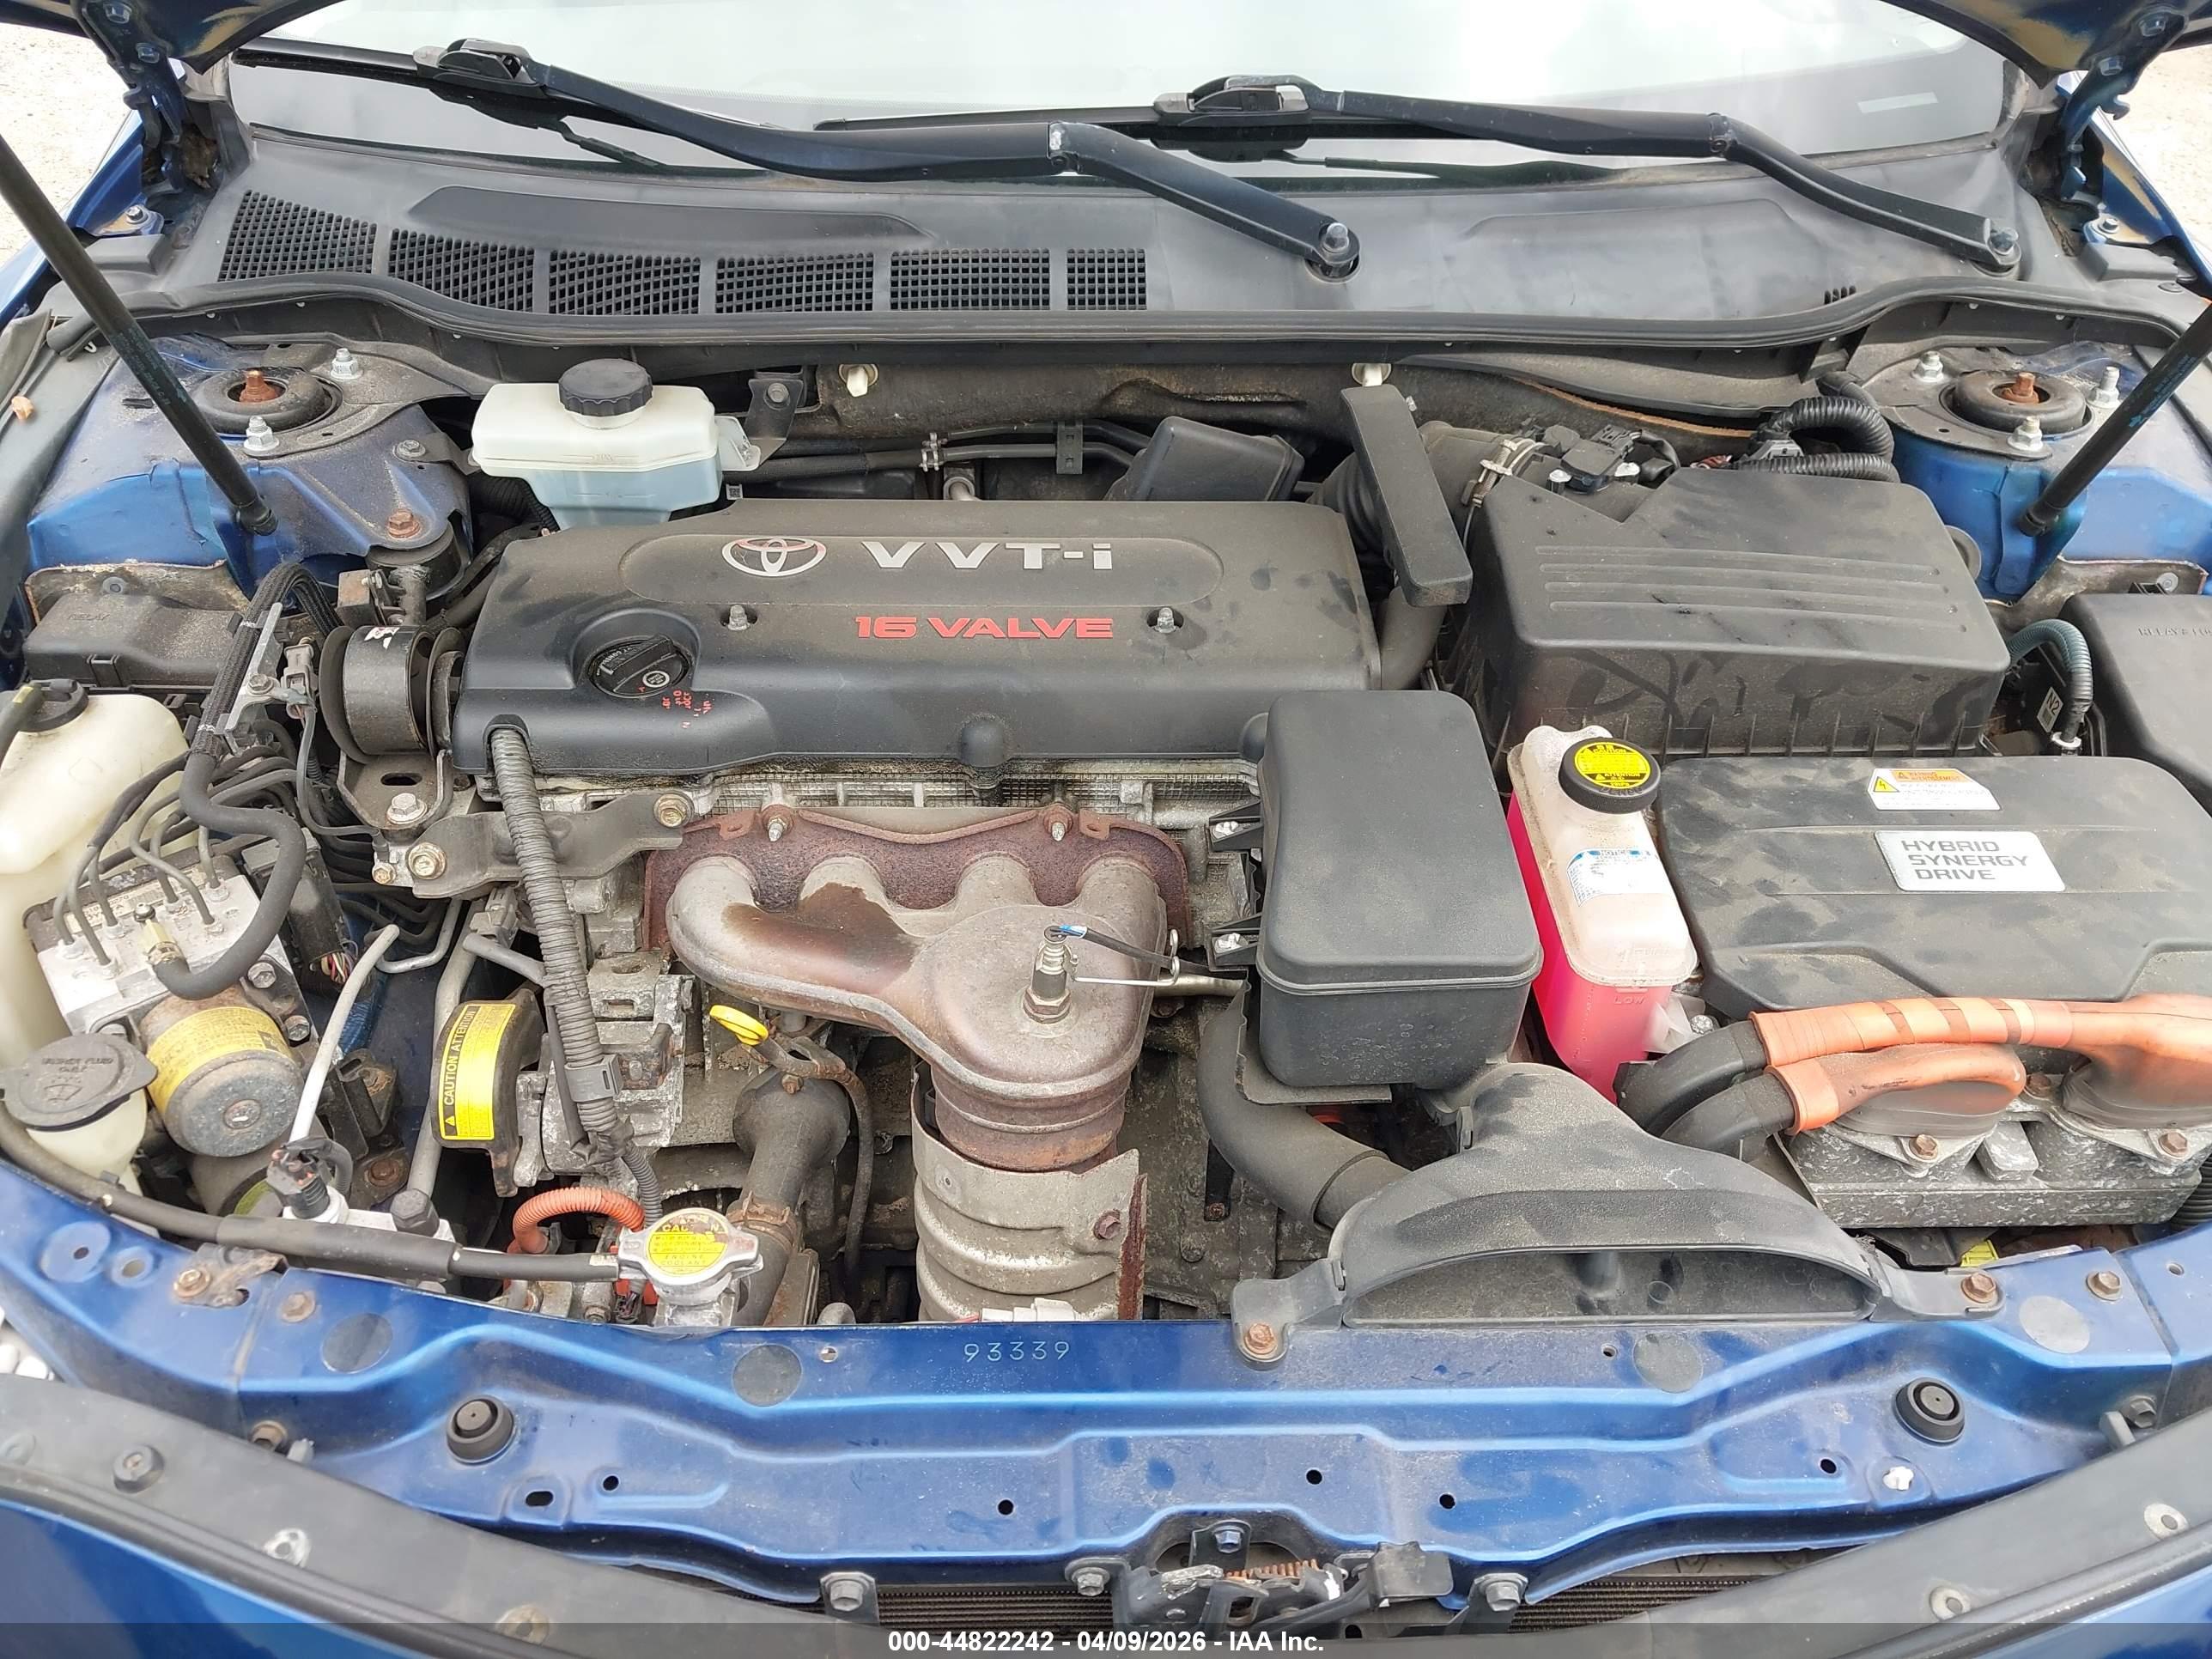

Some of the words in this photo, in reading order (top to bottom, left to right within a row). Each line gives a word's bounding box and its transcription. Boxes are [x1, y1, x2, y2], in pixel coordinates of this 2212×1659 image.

[861, 541, 1113, 570] VVT-i
[854, 616, 918, 640] 16
[927, 617, 1114, 640] VALVE
[2045, 693, 2061, 715] N2
[1901, 840, 2000, 852] HYBRID
[1908, 854, 2029, 866] SYNERGY
[1914, 869, 1996, 880] DRIVE
[443, 1057, 459, 1106] CAUTION
[451, 1010, 477, 1053] ATTENTION
[963, 1340, 1070, 1363] 93339
